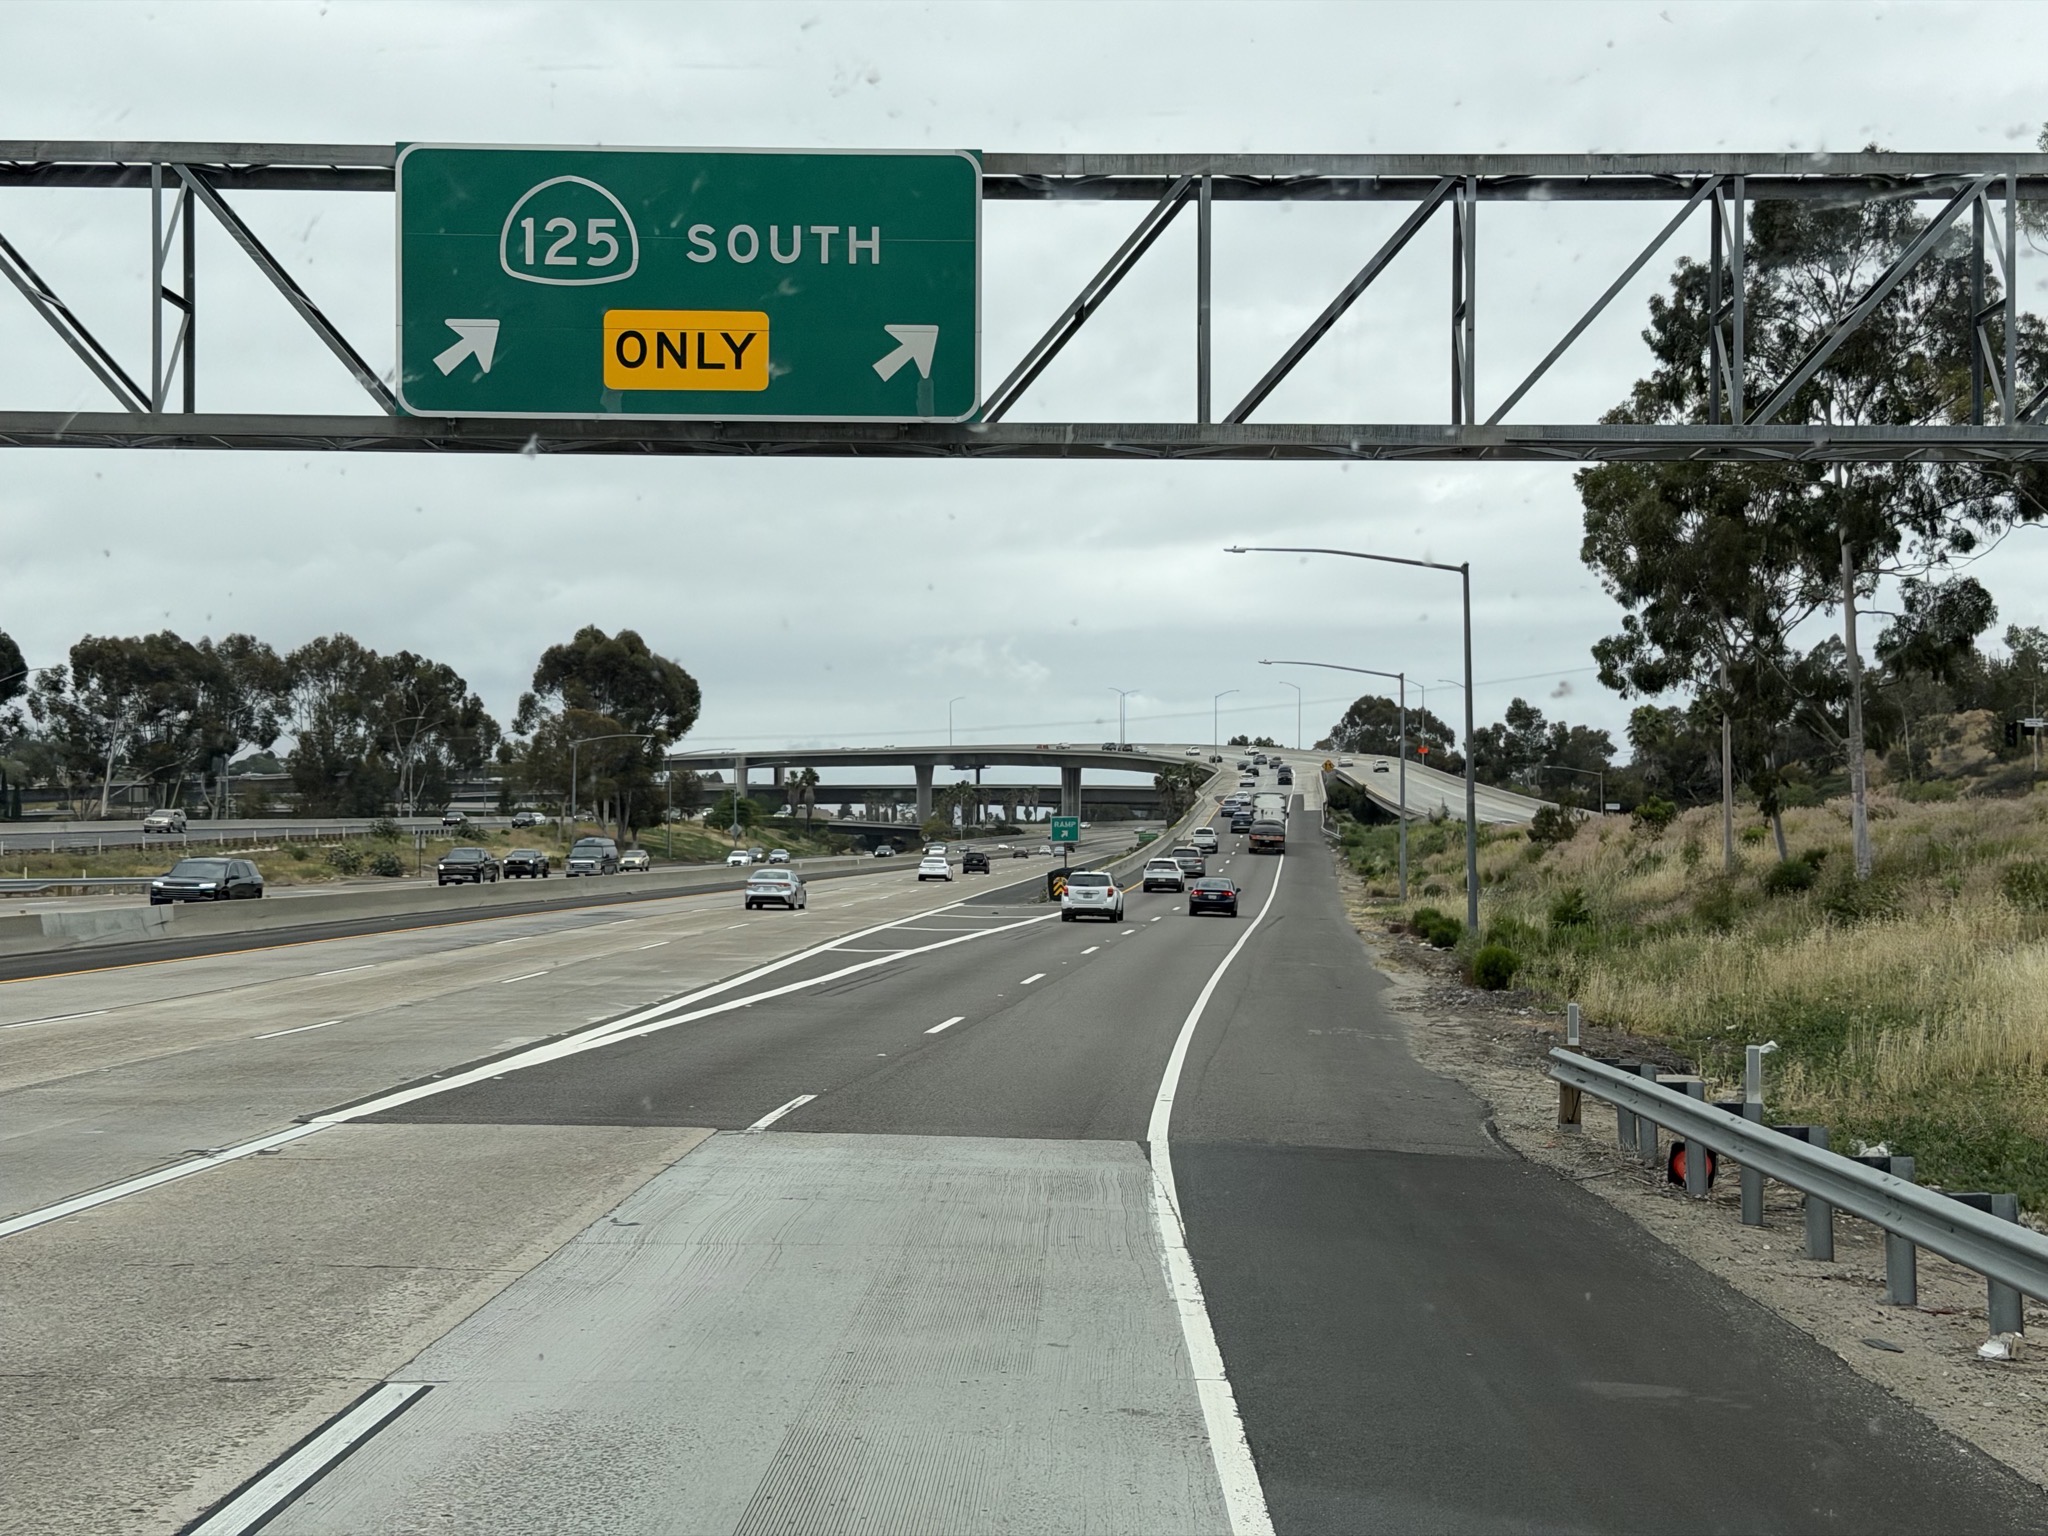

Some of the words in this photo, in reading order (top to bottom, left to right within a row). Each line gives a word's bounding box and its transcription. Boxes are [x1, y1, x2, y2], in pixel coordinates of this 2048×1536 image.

[519, 217, 619, 267] 125
[686, 224, 880, 264] SOUTH
[615, 330, 757, 370] ONLY
